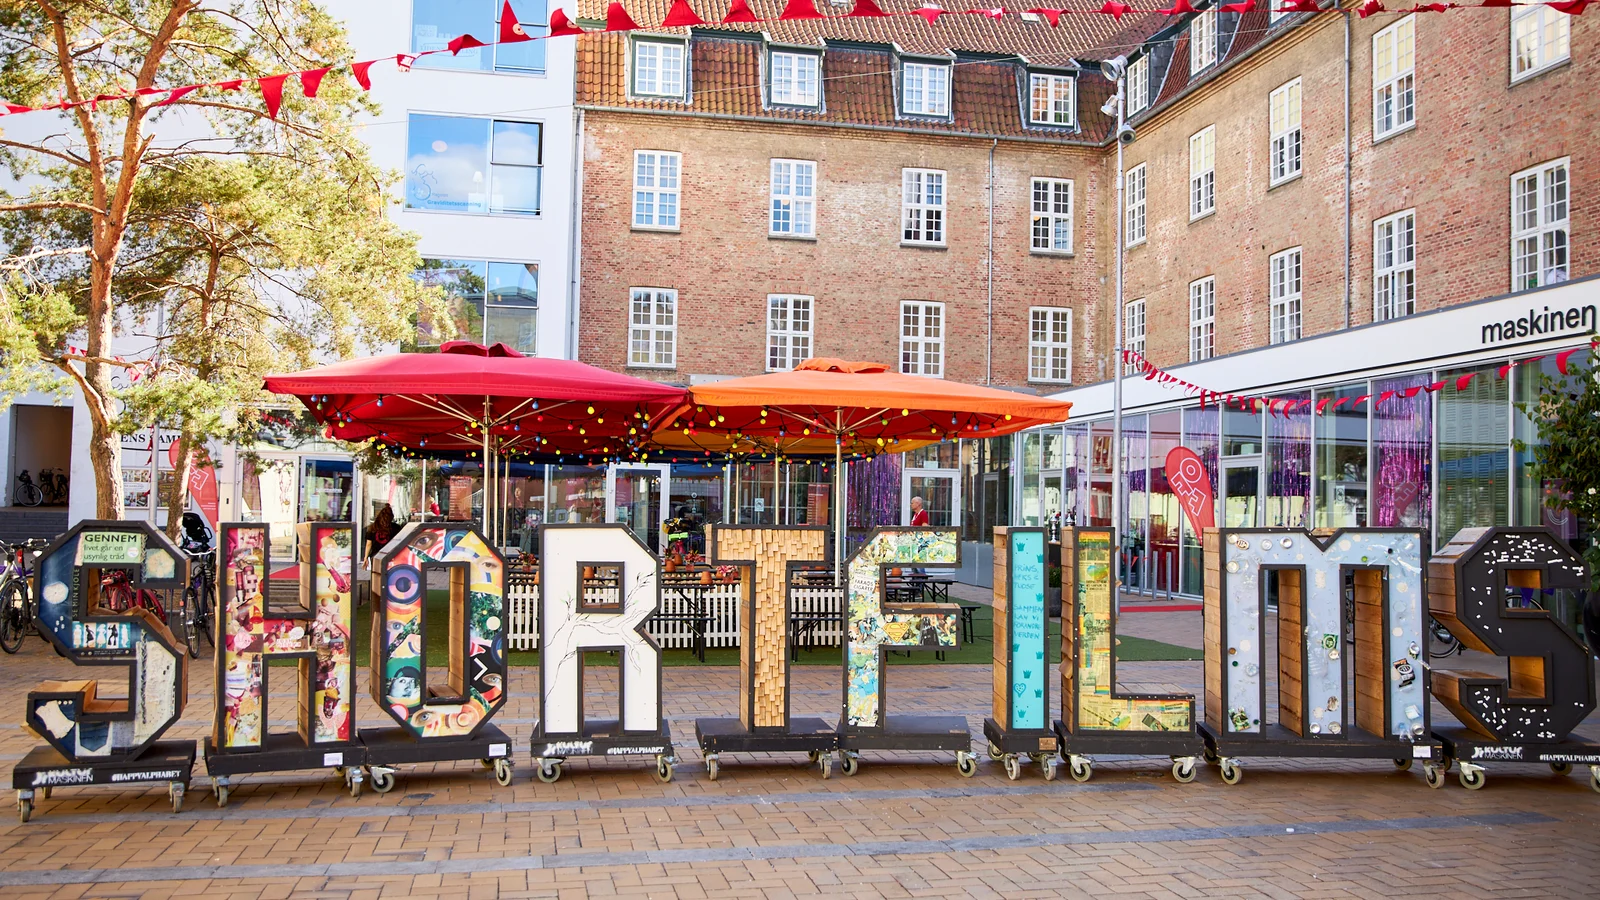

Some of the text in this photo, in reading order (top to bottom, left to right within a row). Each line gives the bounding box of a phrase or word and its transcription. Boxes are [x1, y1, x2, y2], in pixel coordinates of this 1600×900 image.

[1481, 304, 1597, 344] maskinen
[84, 534, 138, 543] GENNEM
[83, 544, 100, 552] livet
[100, 544, 113, 554] går
[83, 552, 125, 562] usynlig tråd
[607, 746, 665, 755] #HAPPYALPHABET
[49, 774, 94, 785] MASKINEN
[111, 769, 182, 782] #HAPPYALPHABET
